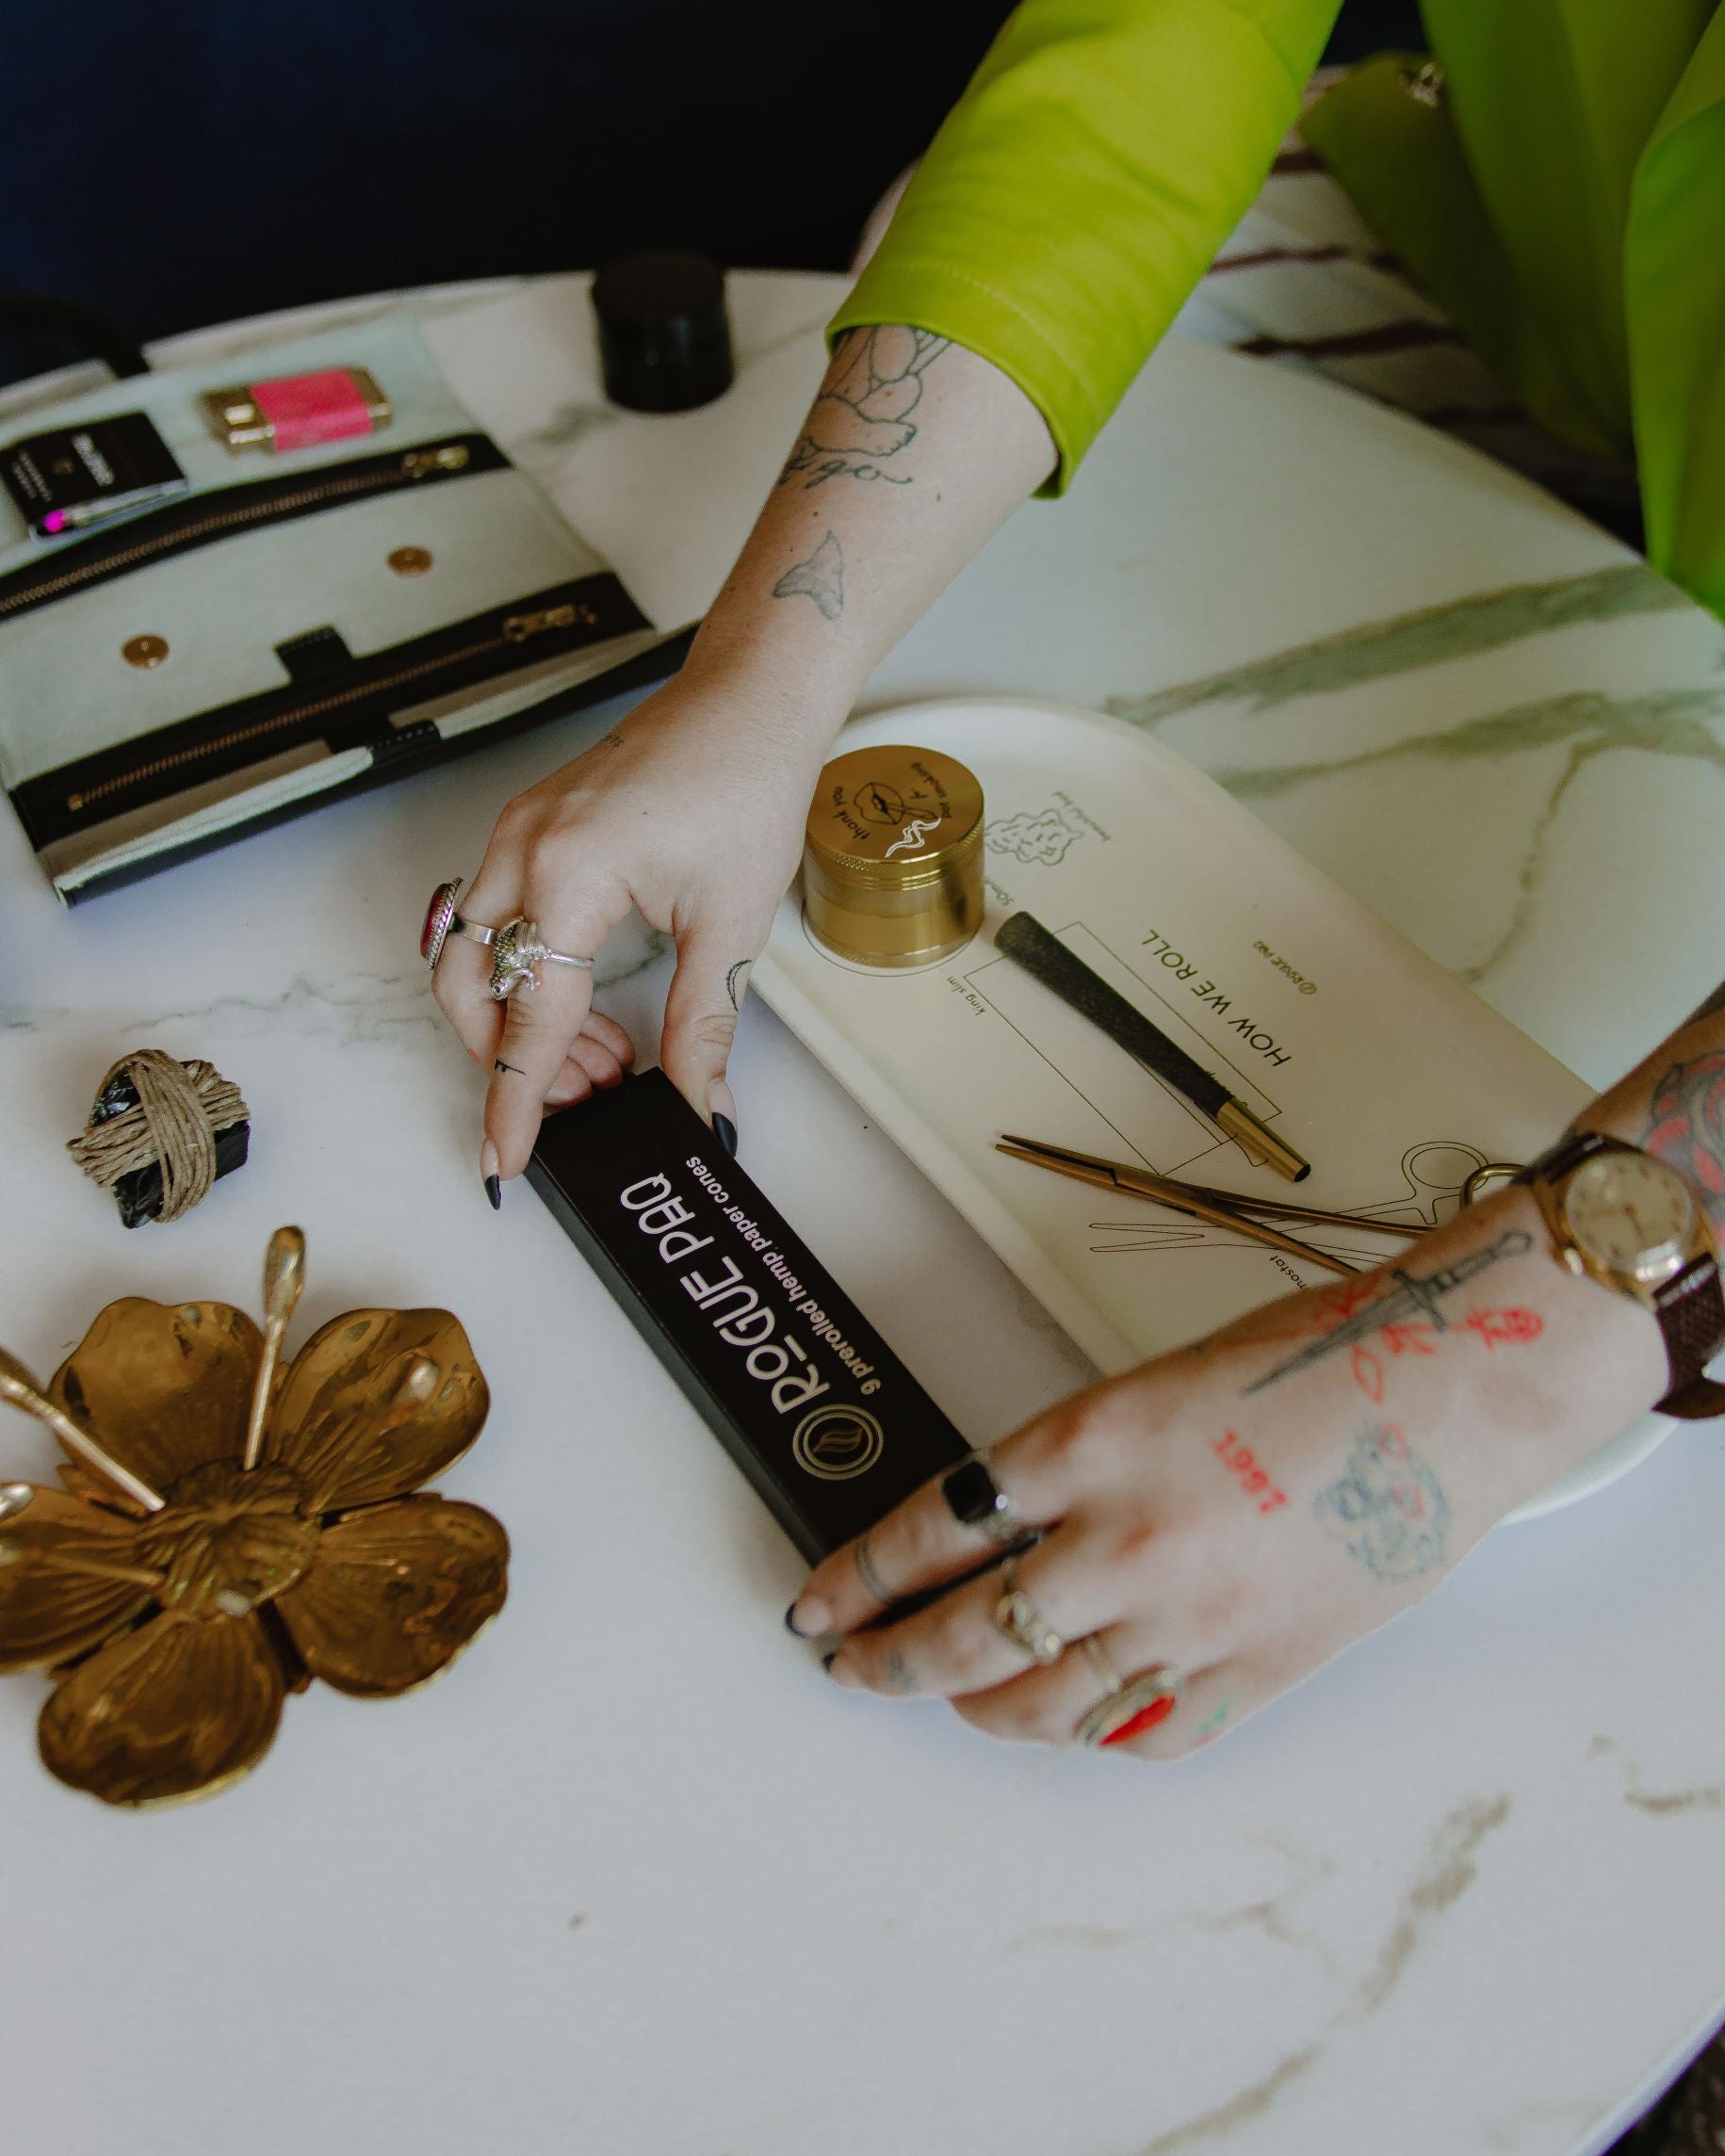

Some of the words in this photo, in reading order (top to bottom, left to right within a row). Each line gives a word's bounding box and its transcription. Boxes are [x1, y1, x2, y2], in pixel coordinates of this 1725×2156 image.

[833, 810, 871, 840] thank
[1142, 929, 1198, 981] ROLL
[947, 976, 968, 995] slim
[965, 994, 987, 1016] king
[1191, 980, 1232, 1015] WE
[1227, 1018, 1293, 1067] HOW
[686, 1156, 730, 1204] cones
[620, 1172, 715, 1264] PAQ
[723, 1206, 773, 1252] paper
[762, 1251, 807, 1303] hemp
[1269, 1256, 1307, 1289] mostat
[796, 1299, 876, 1379] prerolled
[860, 1378, 882, 1396] 9
